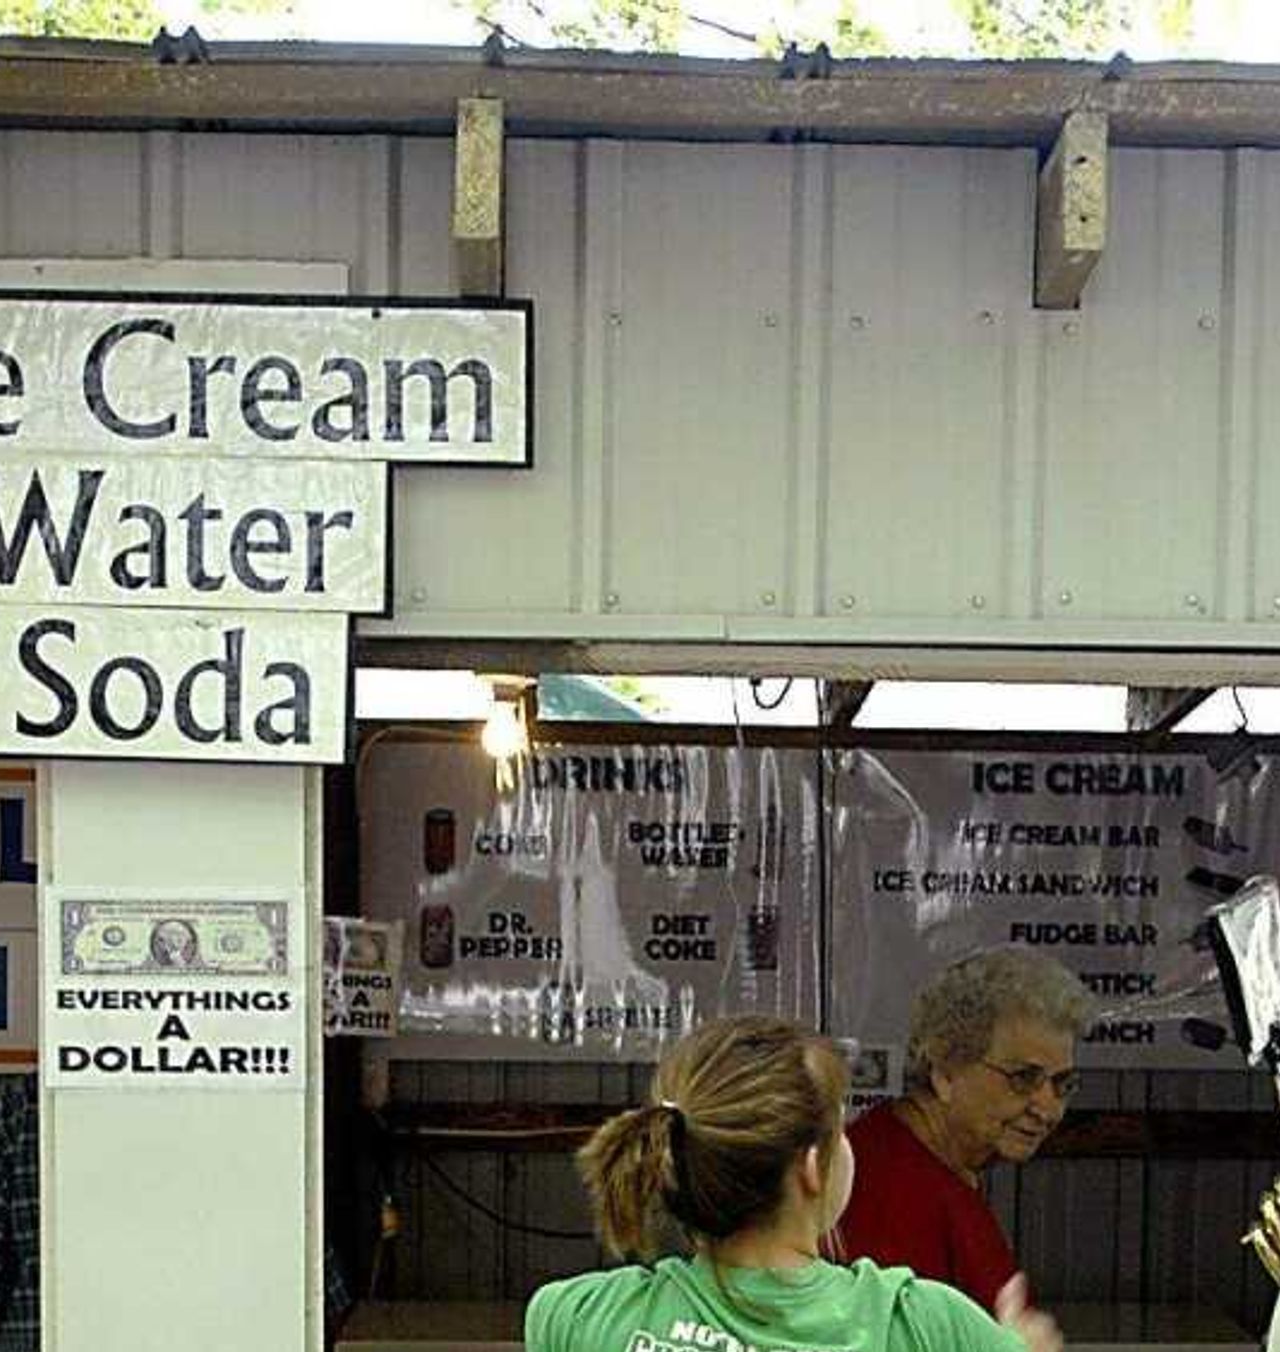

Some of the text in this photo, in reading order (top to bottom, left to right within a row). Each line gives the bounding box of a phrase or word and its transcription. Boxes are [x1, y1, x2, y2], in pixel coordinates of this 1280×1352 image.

[82, 316, 494, 444] Cream
[15, 617, 311, 745] Soda
[972, 762, 1186, 796] ICE CREAM
[962, 824, 1160, 847] ICE CREAM BAR
[874, 871, 915, 892] ICE
[489, 912, 533, 934] DR.
[652, 914, 712, 935] DIET
[1011, 923, 1158, 945] FUDGE BAR
[460, 937, 563, 959] PEPPER
[645, 937, 717, 961] COKE
[1081, 972, 1157, 994] STICK
[57, 989, 290, 1012] EVERYTHINGS
[352, 990, 370, 1007] A
[157, 1015, 190, 1041] A
[1083, 1021, 1156, 1044] UNCH
[59, 1046, 291, 1074] DOLLAR!!!
